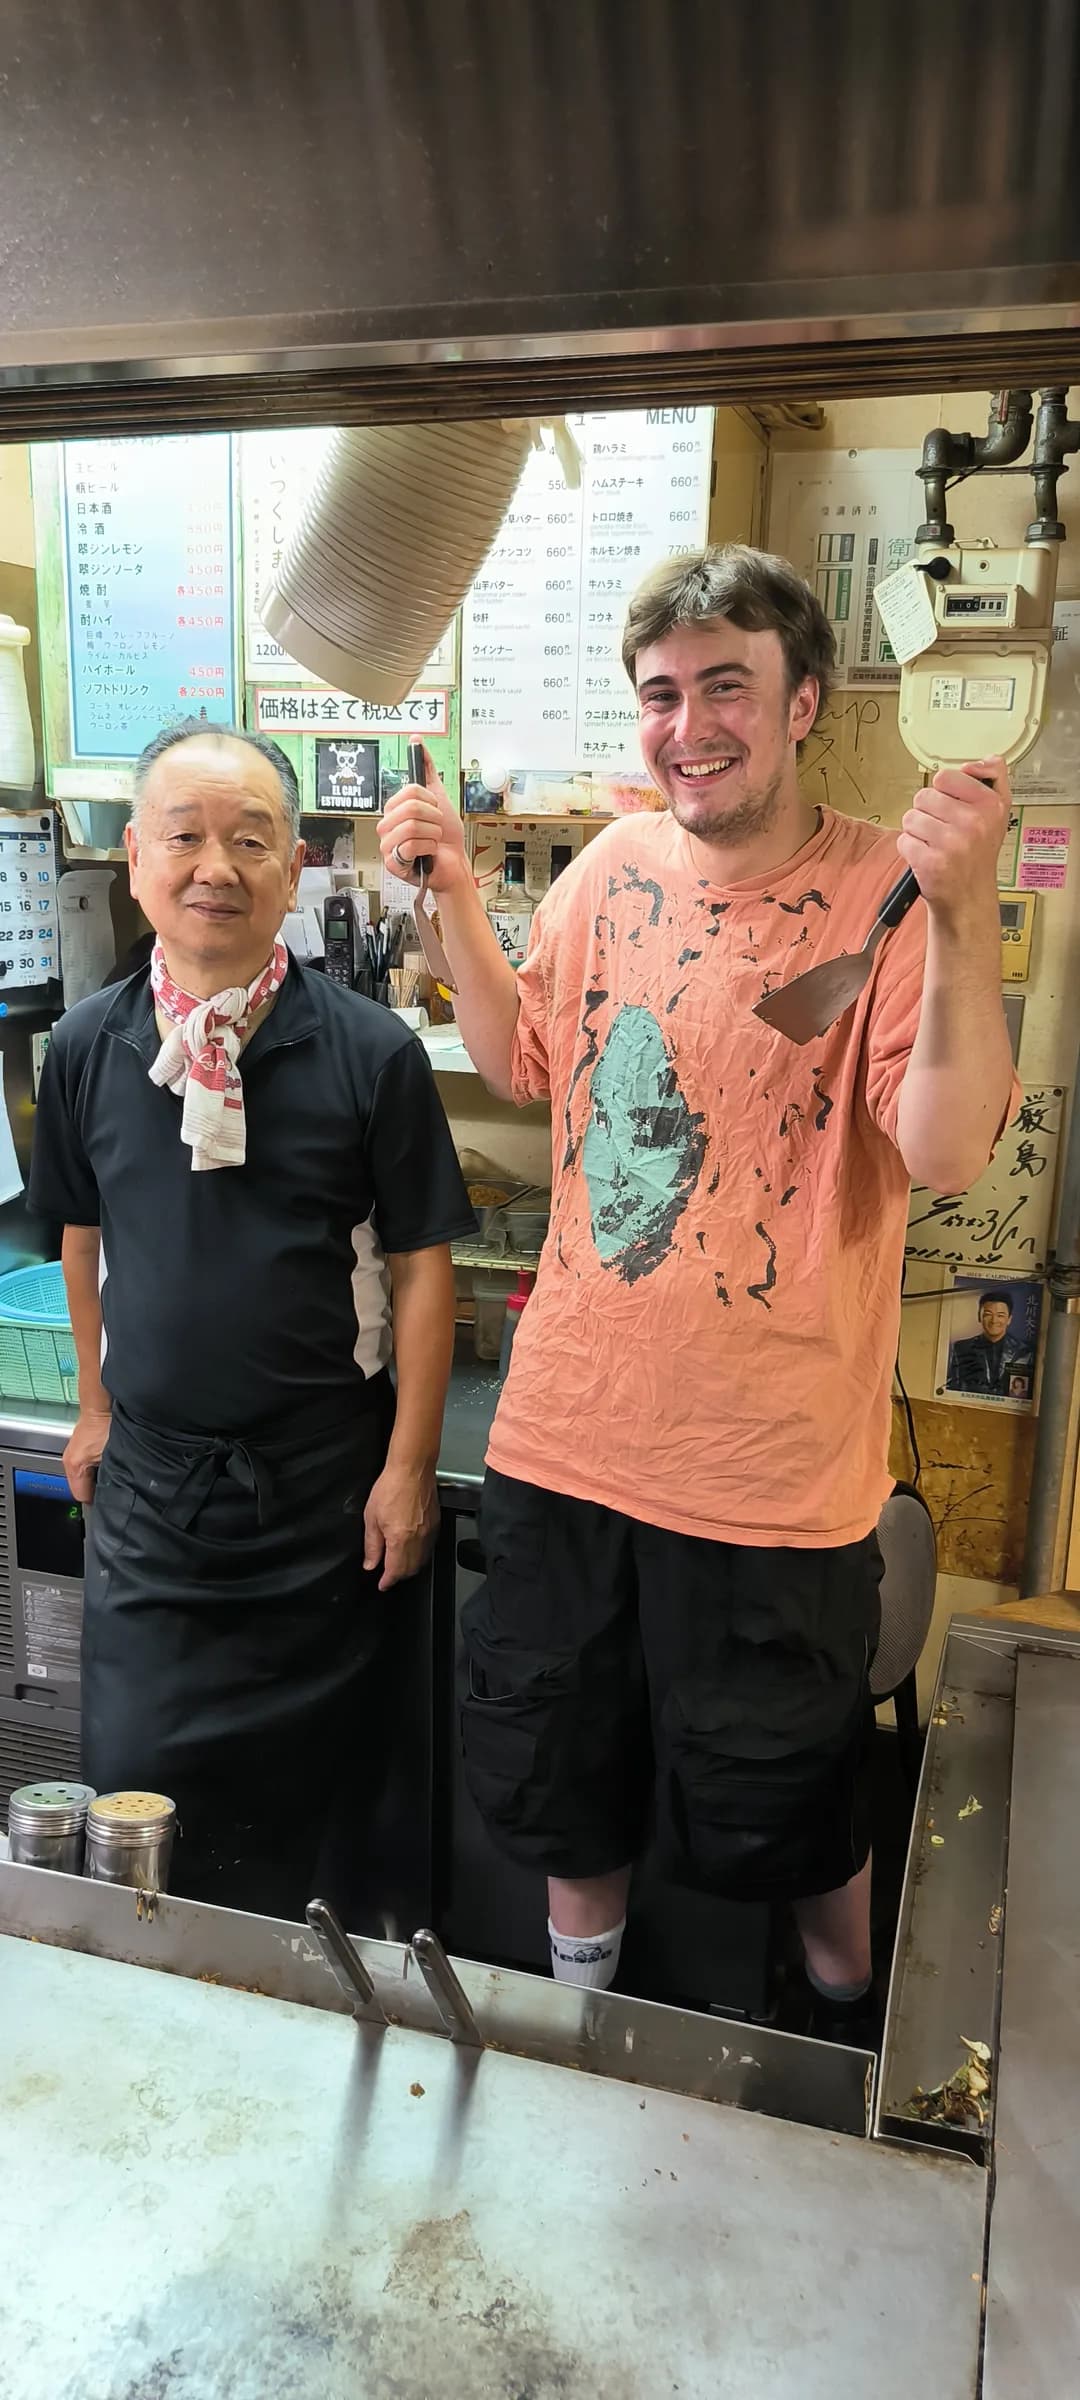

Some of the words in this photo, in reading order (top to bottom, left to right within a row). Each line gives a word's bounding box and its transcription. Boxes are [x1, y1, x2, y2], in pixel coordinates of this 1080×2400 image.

[646, 407, 696, 424] MENU
[592, 478, 644, 488] ハムステーキ
[77, 502, 112, 515] 日本酒
[592, 511, 633, 522] トロロ焼き
[590, 545, 640, 556] ホルモン焼き
[177, 585, 224, 596] 各450円
[589, 580, 622, 590] 牛ハラミ
[80, 613, 113, 627] 酎ハイ
[178, 616, 224, 627] 各450円
[588, 612, 613, 622] コウネ
[472, 646, 513, 655] ウインナー
[586, 646, 612, 655] 牛タン
[83, 664, 136, 676] ハイボール
[189, 667, 225, 677] 450円
[472, 677, 495, 687] セセリ
[83, 683, 149, 696] ソフトドリンク
[179, 687, 225, 698] 各250円
[260, 698, 444, 721] 価格は全て税込です
[471, 708, 495, 718] 豚ミミ
[584, 742, 625, 752] 牛ステーキ
[320, 796, 351, 808] ESTUVO
[20, 842, 27, 853] 2
[39, 842, 47, 853] 3
[20, 871, 28, 882] 9
[38, 871, 49, 882] 10
[19, 901, 31, 911] 16
[38, 900, 50, 911] 17
[18, 929, 34, 940] 23
[38, 928, 53, 939] 24
[19, 958, 34, 969] 30
[40, 956, 52, 967] 31
